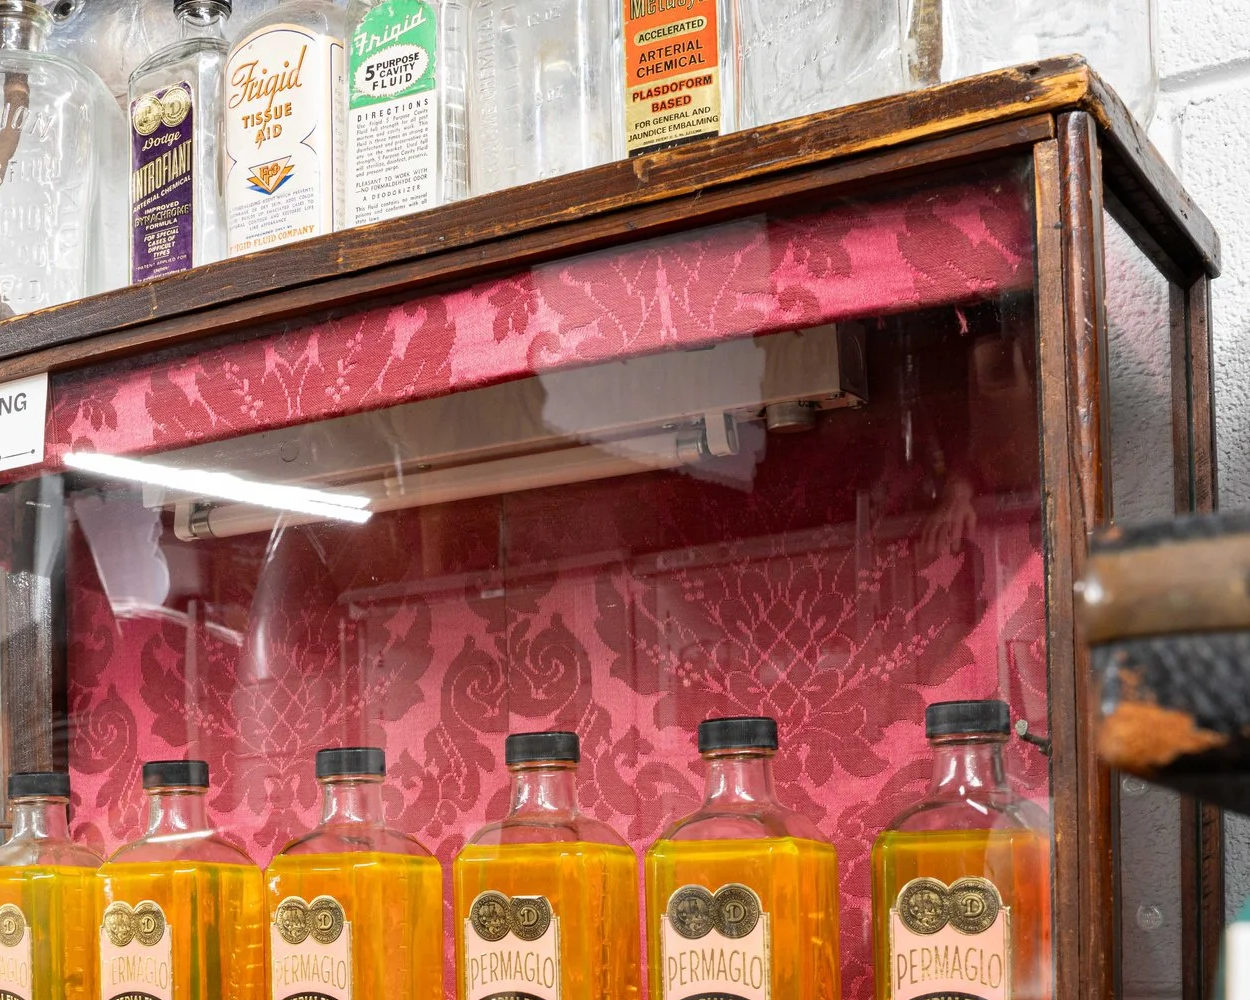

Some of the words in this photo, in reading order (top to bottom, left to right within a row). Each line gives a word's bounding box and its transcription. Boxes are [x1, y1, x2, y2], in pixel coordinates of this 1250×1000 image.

[354, 7, 426, 56] Frigid
[638, 19, 703, 43] ACCELERATED
[639, 39, 703, 64] ARTERIAL
[365, 65, 374, 81] 5
[377, 52, 419, 70] PURPOSE
[380, 62, 415, 77] CAVITY
[636, 53, 705, 78] CHEMICAL
[229, 45, 307, 113] Frigid
[372, 73, 412, 90] FLUID
[632, 75, 712, 102] PLASDOFORM
[242, 102, 292, 129] TISSUE
[357, 99, 428, 122] DIRECTIONS
[652, 95, 691, 113] BASED
[628, 125, 667, 142] JAUNDICE
[669, 115, 718, 134] EMBALMING
[635, 120, 651, 130] FOR
[653, 111, 690, 125] GENERAL
[692, 106, 710, 115] AND
[142, 131, 181, 151] Dodge
[255, 124, 282, 144] AID
[133, 139, 192, 203] INTROFIANT
[133, 193, 159, 214] ARTERIAL
[161, 175, 191, 196] CHEMICAL
[145, 201, 179, 214] IMPROVED
[144, 233, 156, 242] FOR
[156, 228, 179, 239] SPECIAL
[145, 218, 177, 230] FORMULA
[278, 225, 314, 240] COMPANY
[148, 237, 167, 247] CASES
[148, 242, 175, 253] DIFFICULT
[153, 249, 170, 258] TYPES
[110, 956, 168, 989] ERMAGLO
[276, 954, 346, 991] PERMAGLO
[471, 950, 554, 990] PERMAGLO
[668, 948, 763, 991] PERMAGLO
[898, 945, 1002, 990] PERMAGLO
